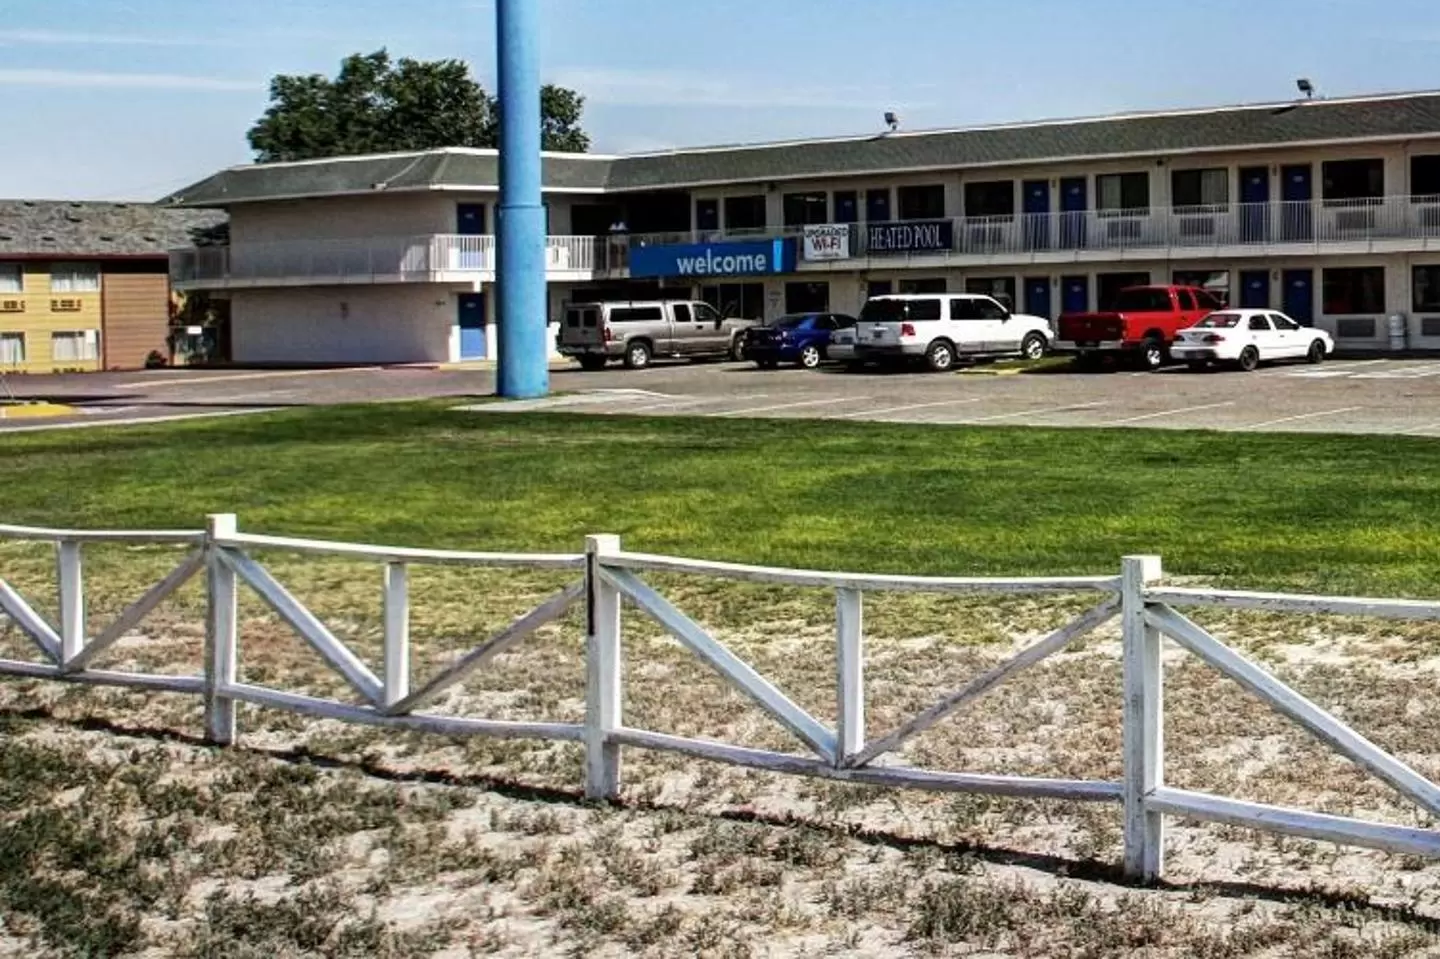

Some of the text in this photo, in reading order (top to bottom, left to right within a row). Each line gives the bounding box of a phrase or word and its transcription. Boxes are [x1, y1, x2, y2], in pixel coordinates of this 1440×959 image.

[870, 223, 944, 250] HEATED POOL
[676, 250, 767, 275] welcome
